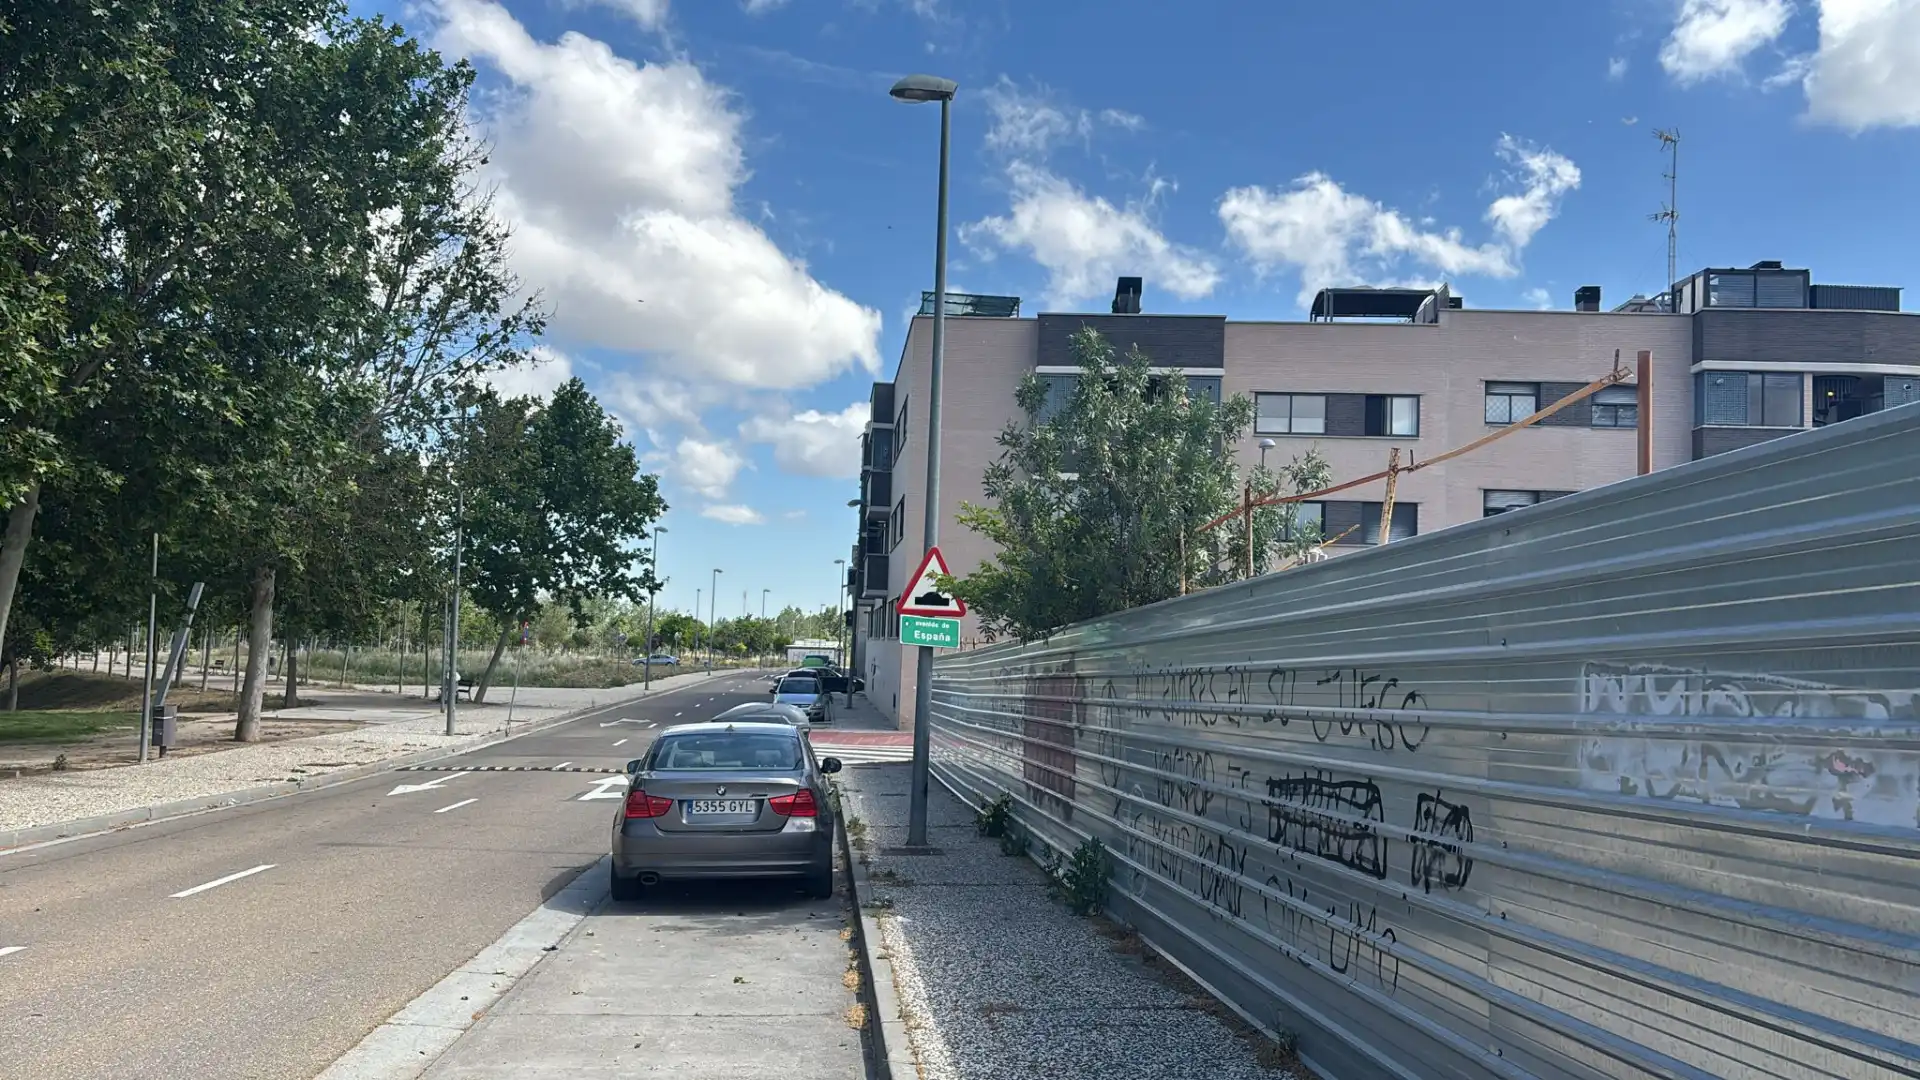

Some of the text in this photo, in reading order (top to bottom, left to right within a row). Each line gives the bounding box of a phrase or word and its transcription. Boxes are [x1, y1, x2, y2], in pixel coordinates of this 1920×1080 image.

[914, 630, 951, 642] España
[695, 801, 753, 813] 5355 GYL
